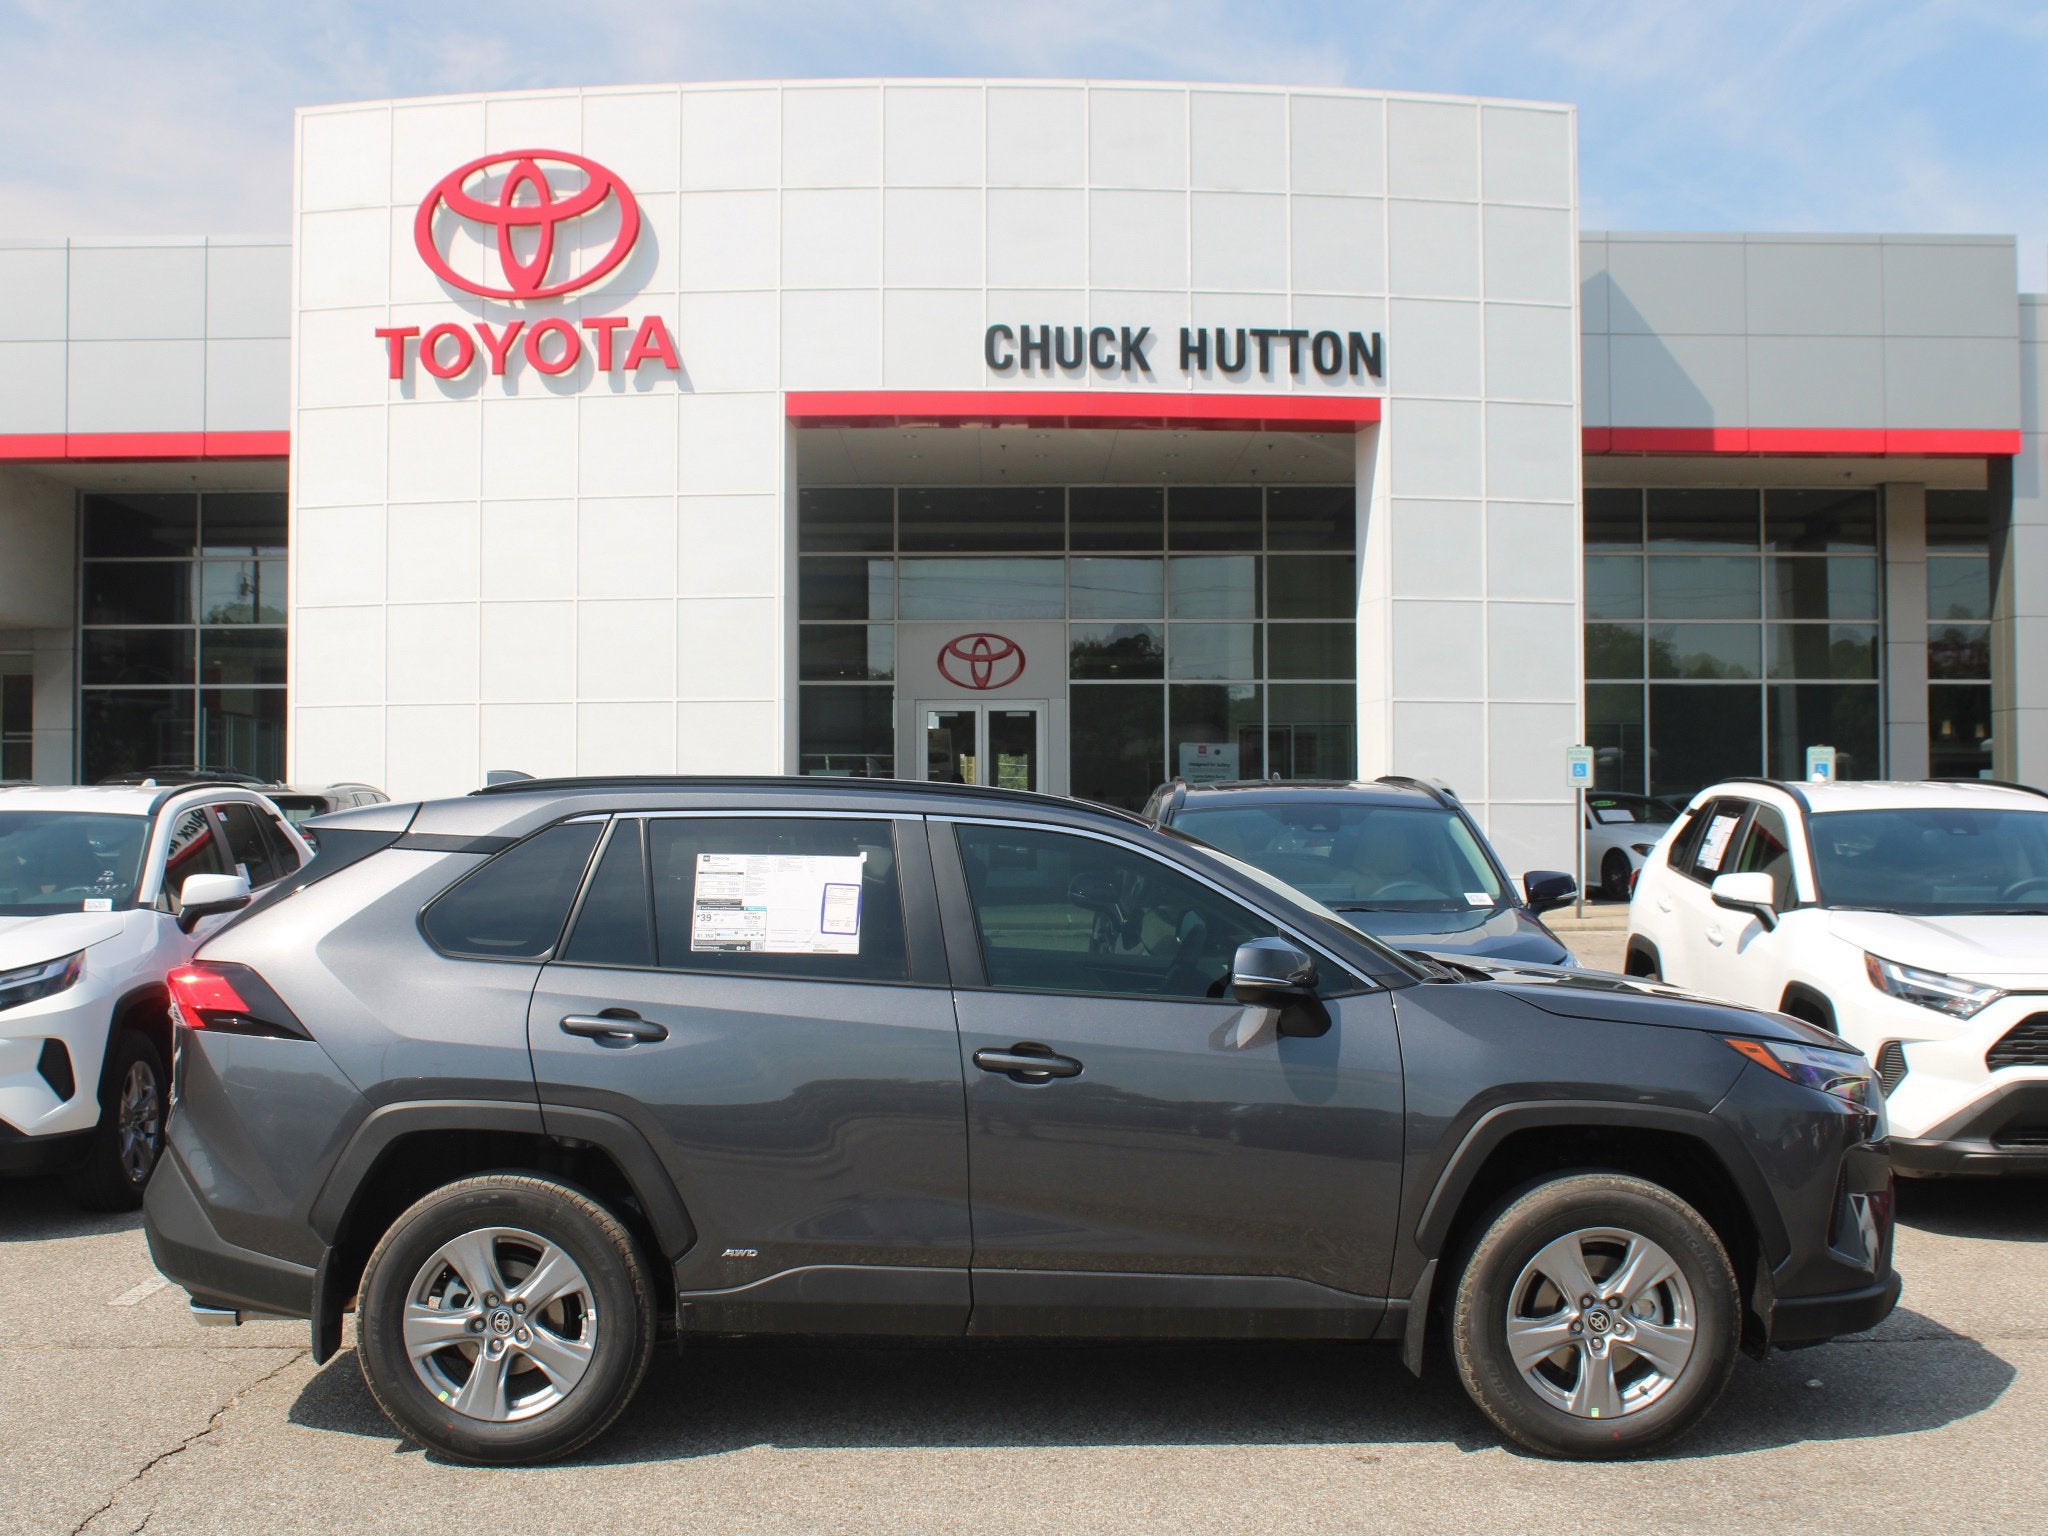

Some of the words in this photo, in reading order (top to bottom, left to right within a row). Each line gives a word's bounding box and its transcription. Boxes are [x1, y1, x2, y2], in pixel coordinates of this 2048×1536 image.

[375, 316, 680, 379] TOYOTA
[985, 324, 1150, 372] CHUCK
[1180, 328, 1382, 377] HUTTON
[700, 913, 712, 922] 39
[721, 1248, 759, 1257] AWD
